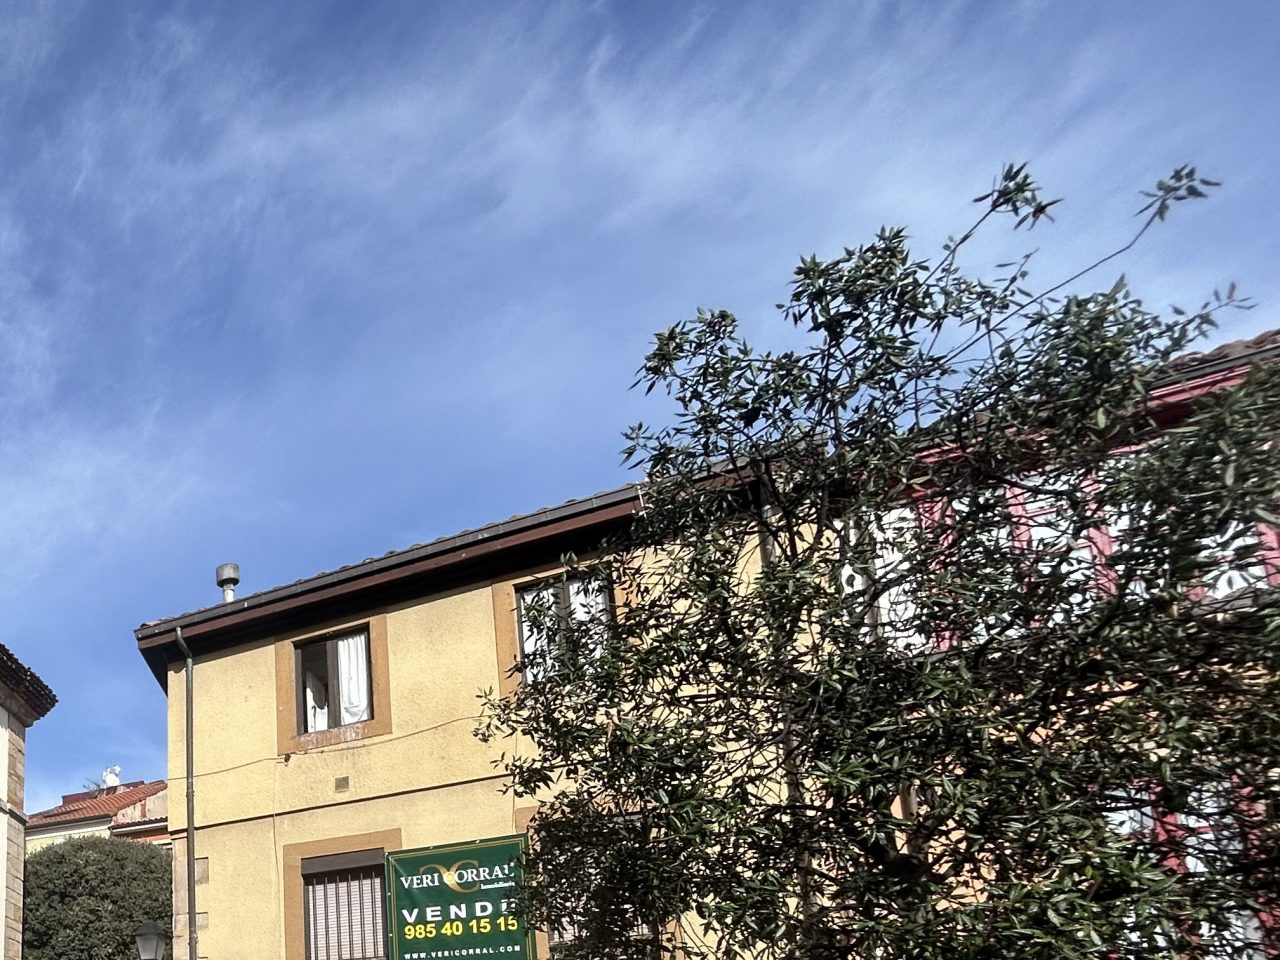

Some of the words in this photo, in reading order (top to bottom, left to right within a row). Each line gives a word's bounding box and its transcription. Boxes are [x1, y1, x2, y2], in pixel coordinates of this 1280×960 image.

[400, 872, 440, 889] VERI
[404, 923, 437, 940] 985
[441, 921, 463, 936] 40
[468, 918, 491, 934] 15
[496, 915, 518, 931] 15
[404, 944, 521, 960] WWW.VERICORRAL.COM
